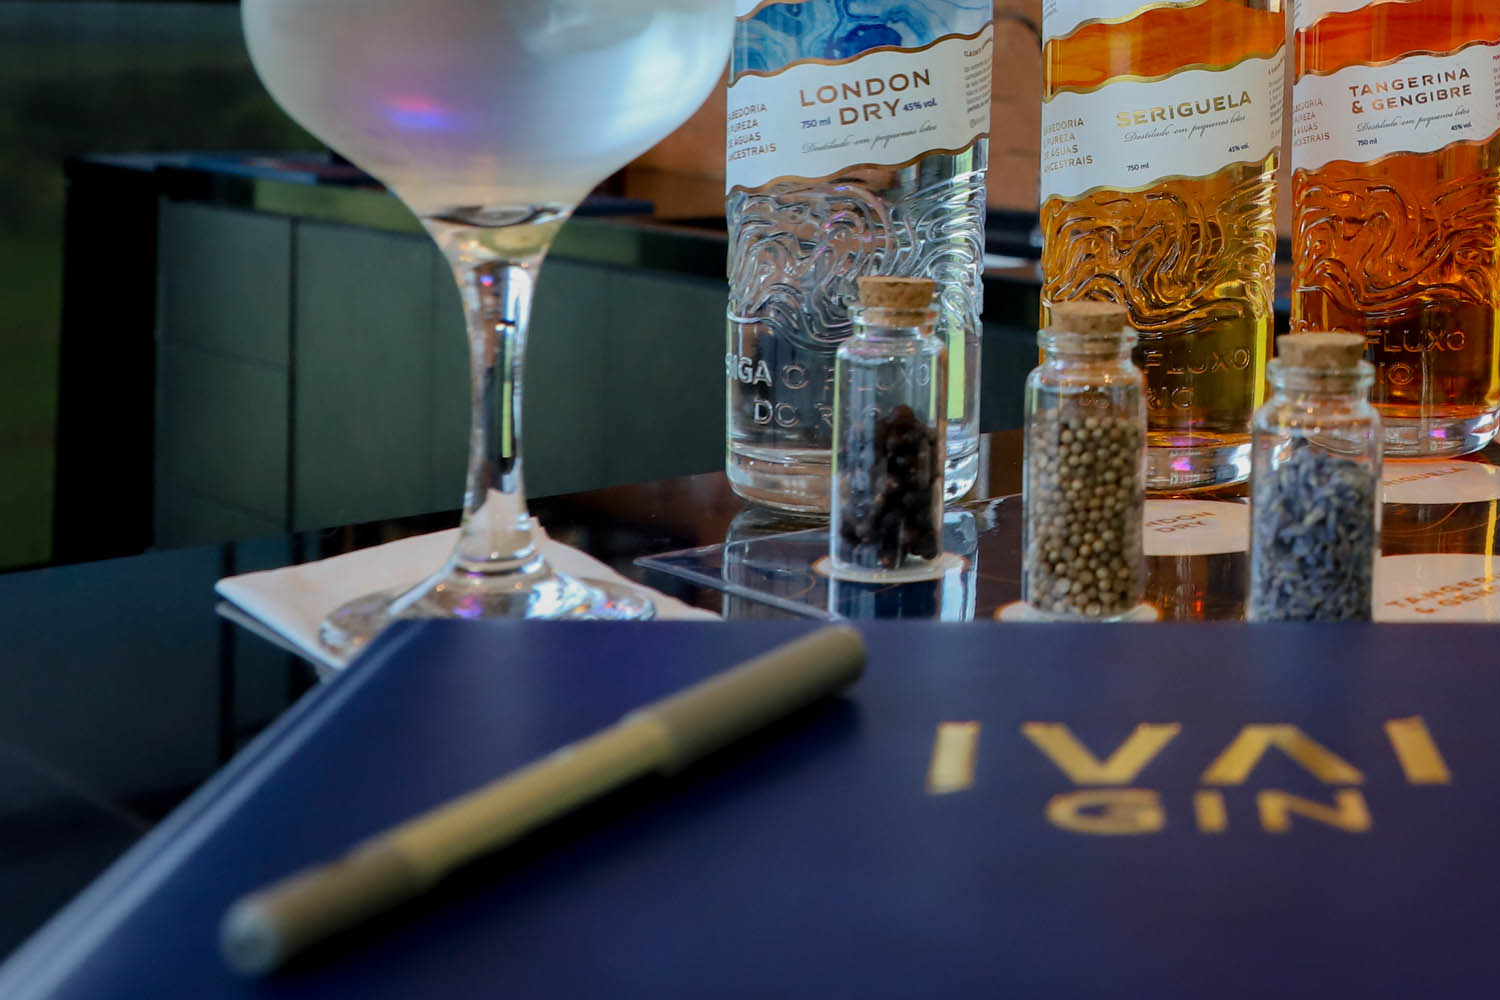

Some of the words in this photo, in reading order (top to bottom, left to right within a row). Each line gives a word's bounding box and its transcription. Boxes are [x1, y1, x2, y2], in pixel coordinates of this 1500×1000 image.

[800, 69, 931, 107] LONDON
[1349, 68, 1470, 97] TANGERINA
[903, 100, 922, 112] 45%
[1116, 91, 1252, 128] SERIGUELA
[1352, 100, 1363, 114] &
[1372, 84, 1472, 111] GENGIBRE
[729, 104, 767, 120] ABEDORIA
[800, 119, 817, 129] 750
[819, 116, 831, 127] ml
[839, 98, 900, 125] DRY
[1415, 112, 1453, 129] pequenos
[1045, 117, 1084, 134] ABEDORIA
[1123, 123, 1170, 142] Destilado
[1188, 119, 1229, 140] pequenos
[1126, 163, 1140, 172] 750
[1140, 161, 1150, 170] ml
[1364, 329, 1465, 352] FLUXO
[753, 399, 799, 427] DO
[1045, 788, 1371, 834] GIN
